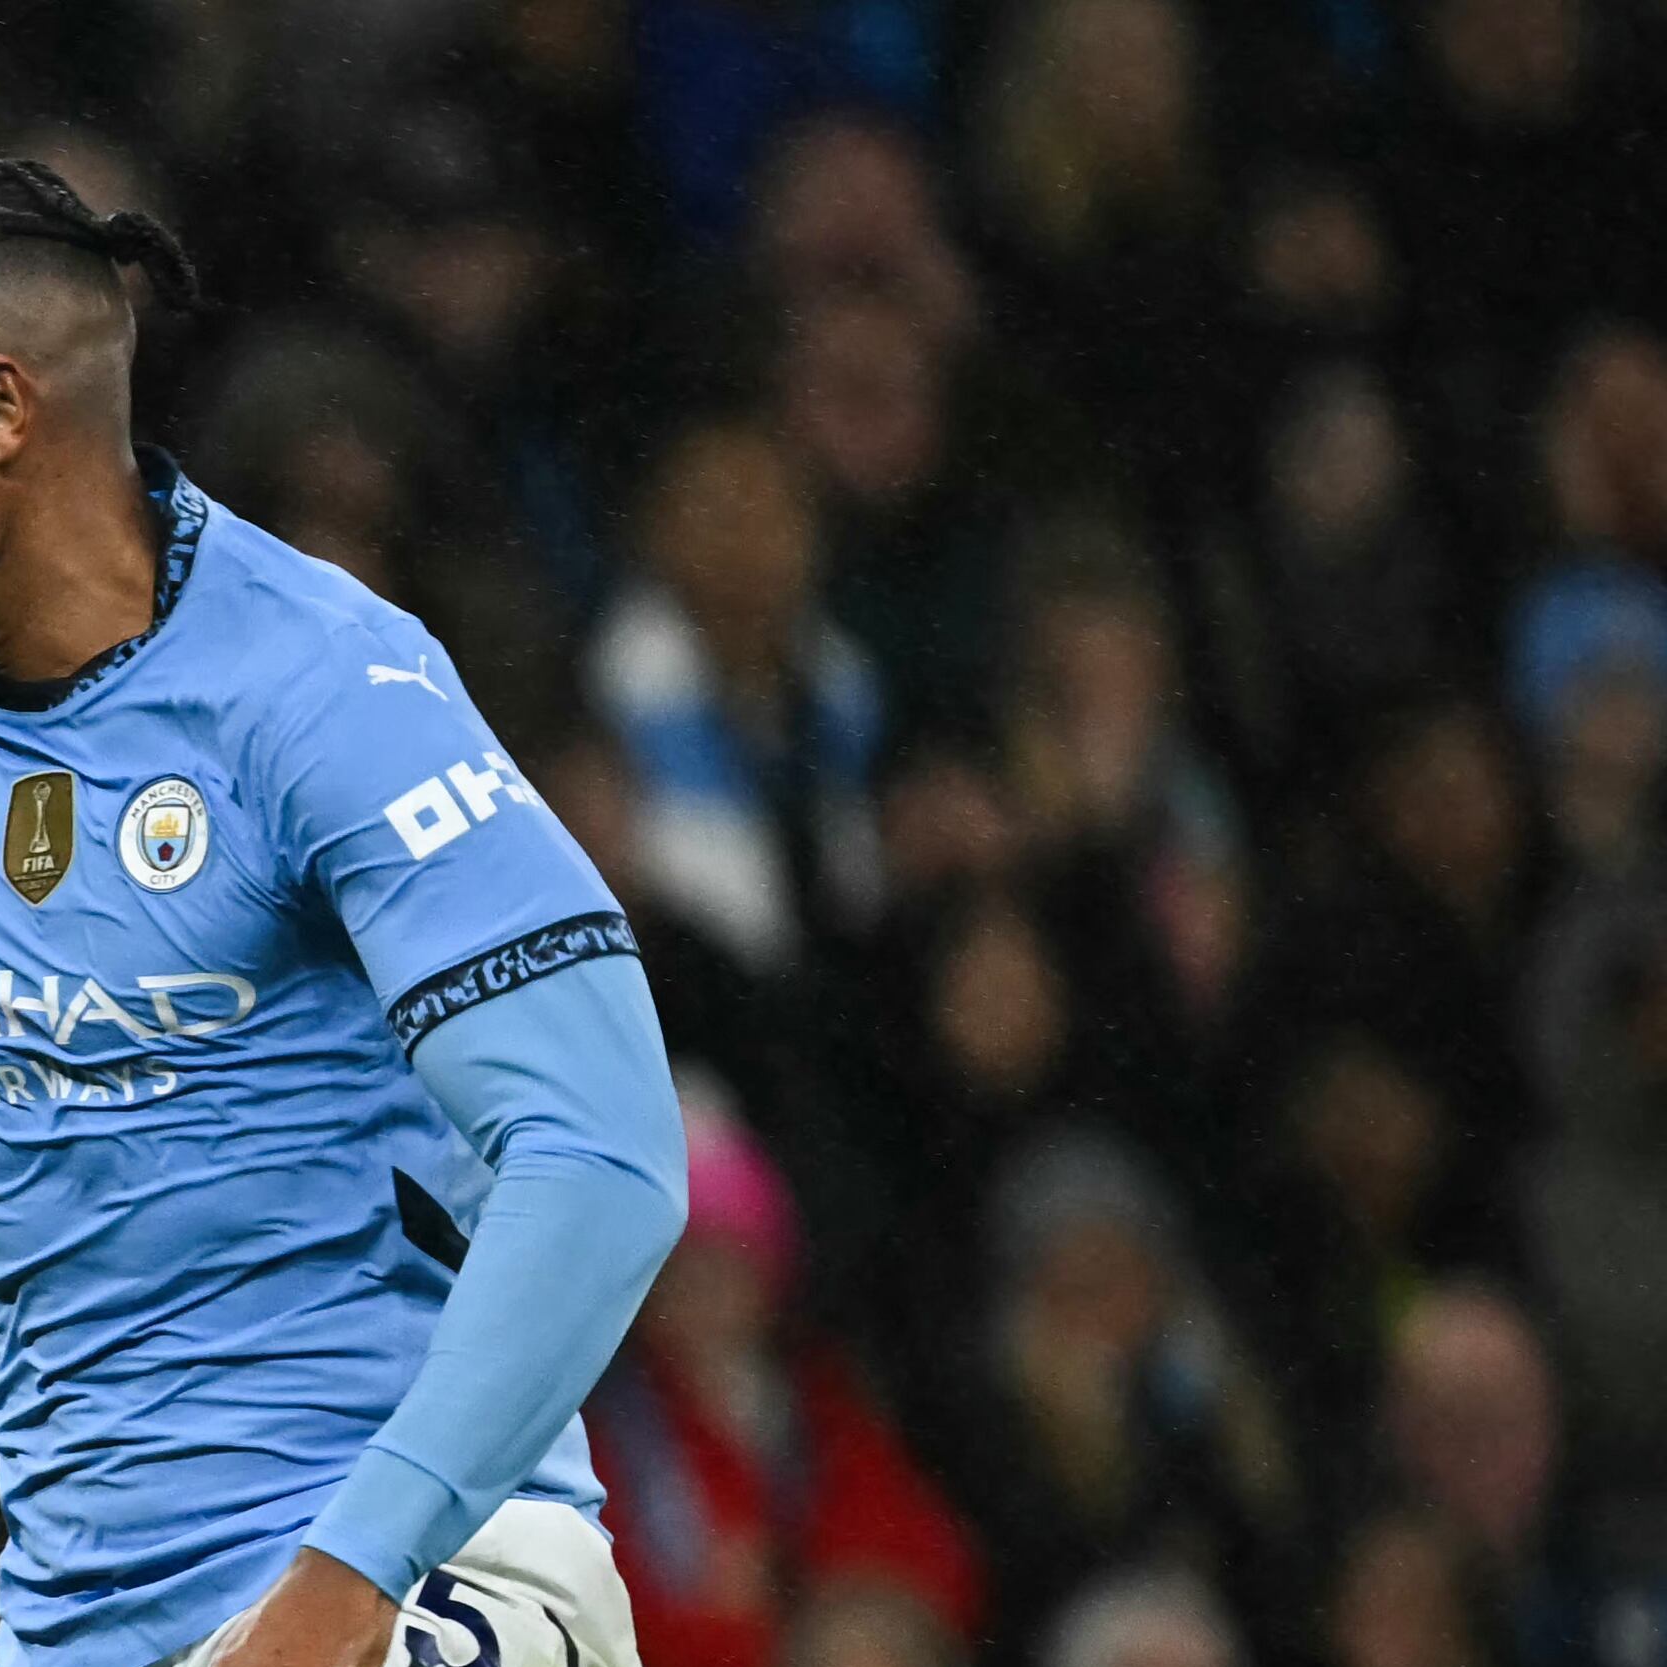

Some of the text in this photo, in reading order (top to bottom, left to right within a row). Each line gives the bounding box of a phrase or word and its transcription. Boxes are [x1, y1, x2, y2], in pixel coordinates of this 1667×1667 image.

[130, 784, 204, 818] MANCHESTER
[383, 751, 540, 861] OK
[22, 854, 55, 873] FIFA
[149, 874, 178, 885] CITY
